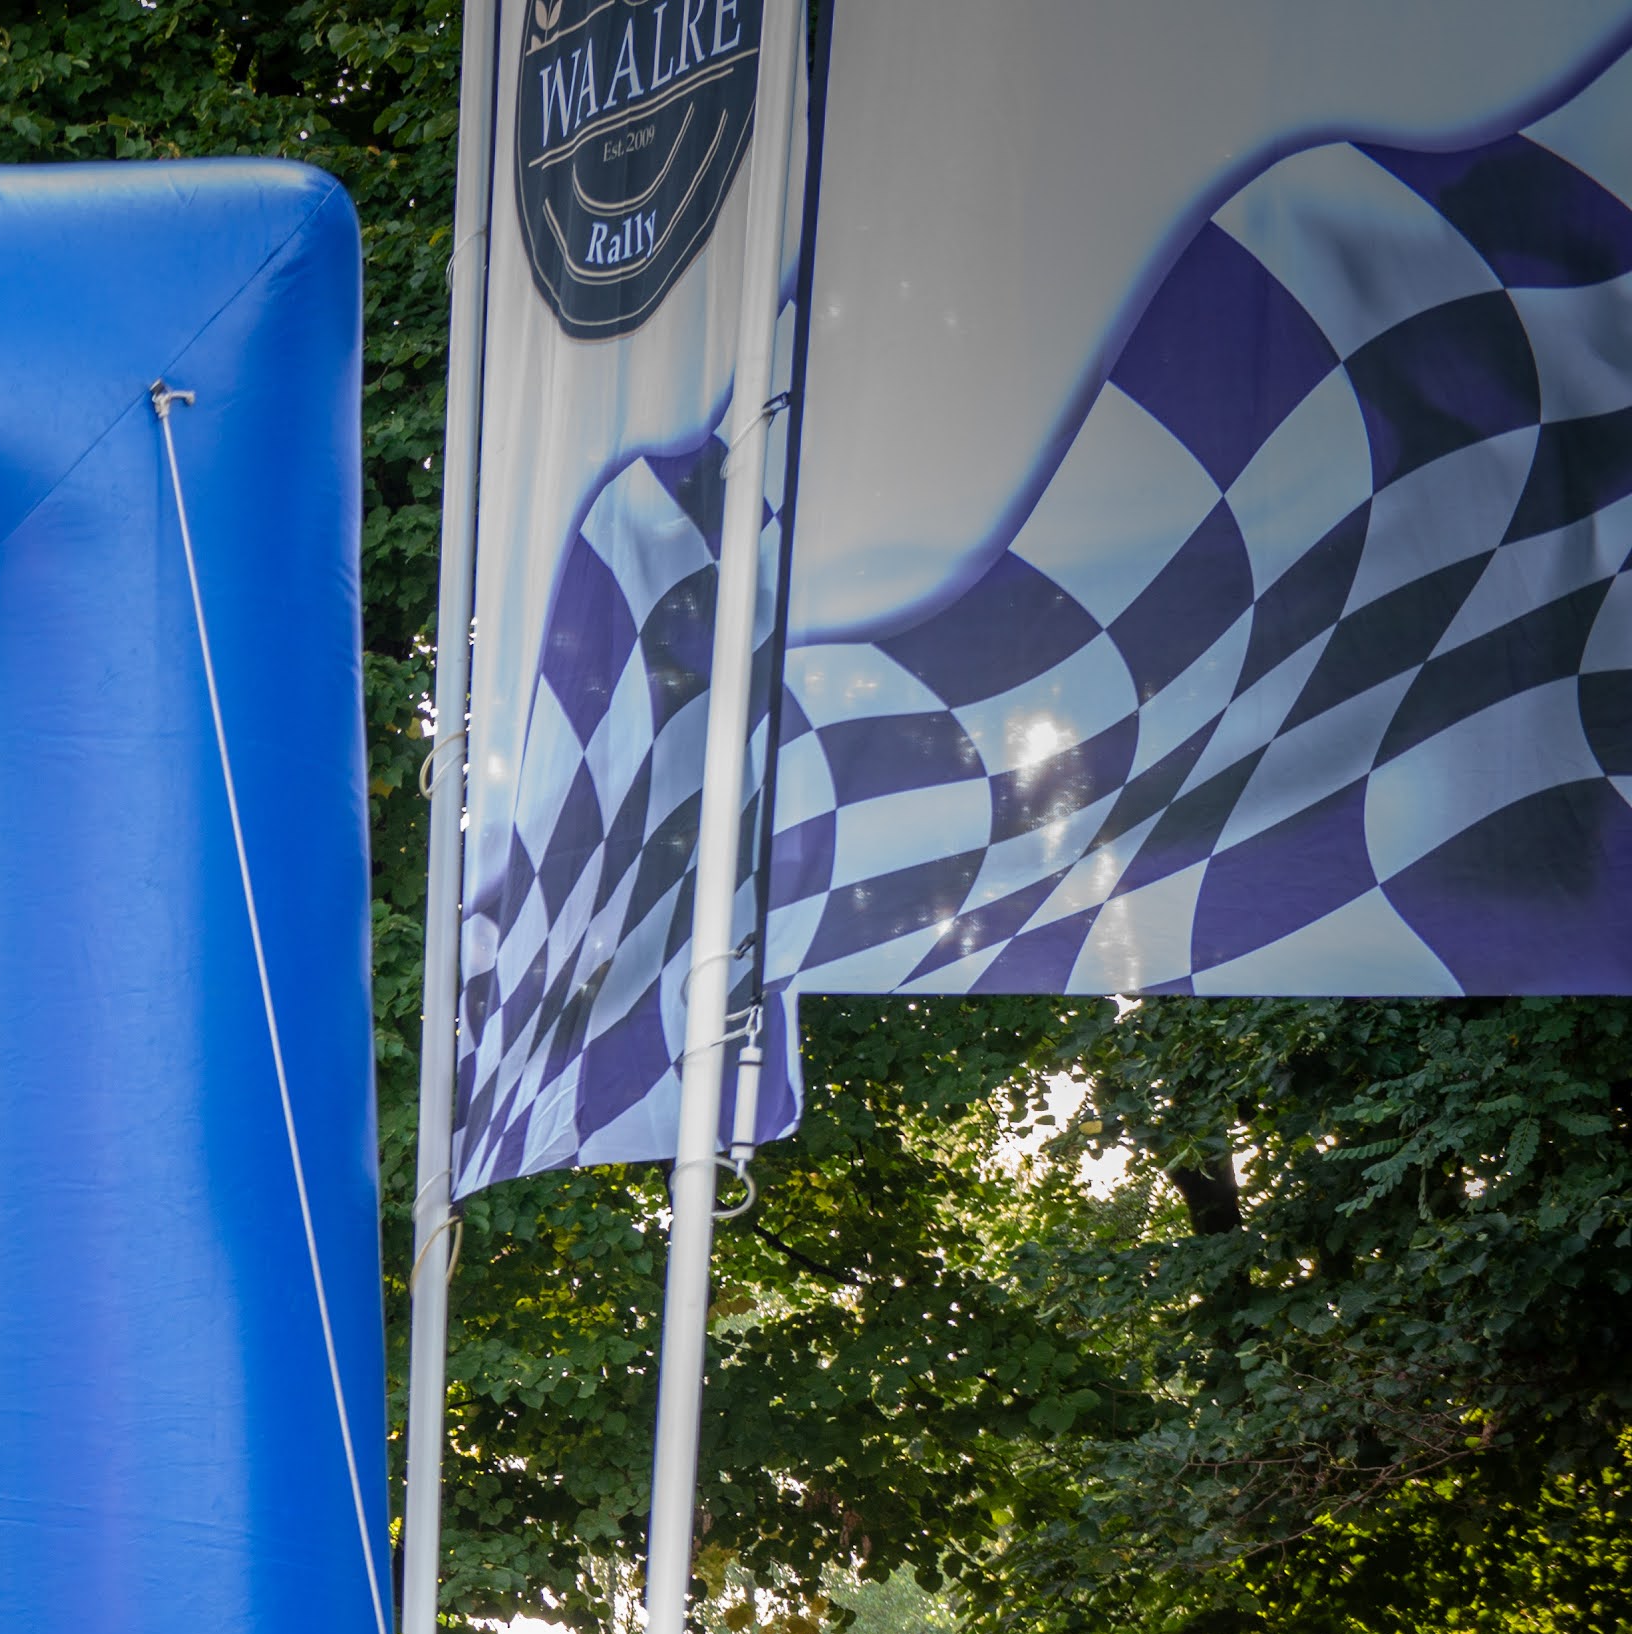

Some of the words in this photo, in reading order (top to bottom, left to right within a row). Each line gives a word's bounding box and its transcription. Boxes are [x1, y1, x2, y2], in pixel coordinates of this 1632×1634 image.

[539, 0, 741, 148] WAALRE
[603, 140, 625, 162] Est.
[626, 124, 656, 154] 2009
[585, 209, 657, 264] Rally
